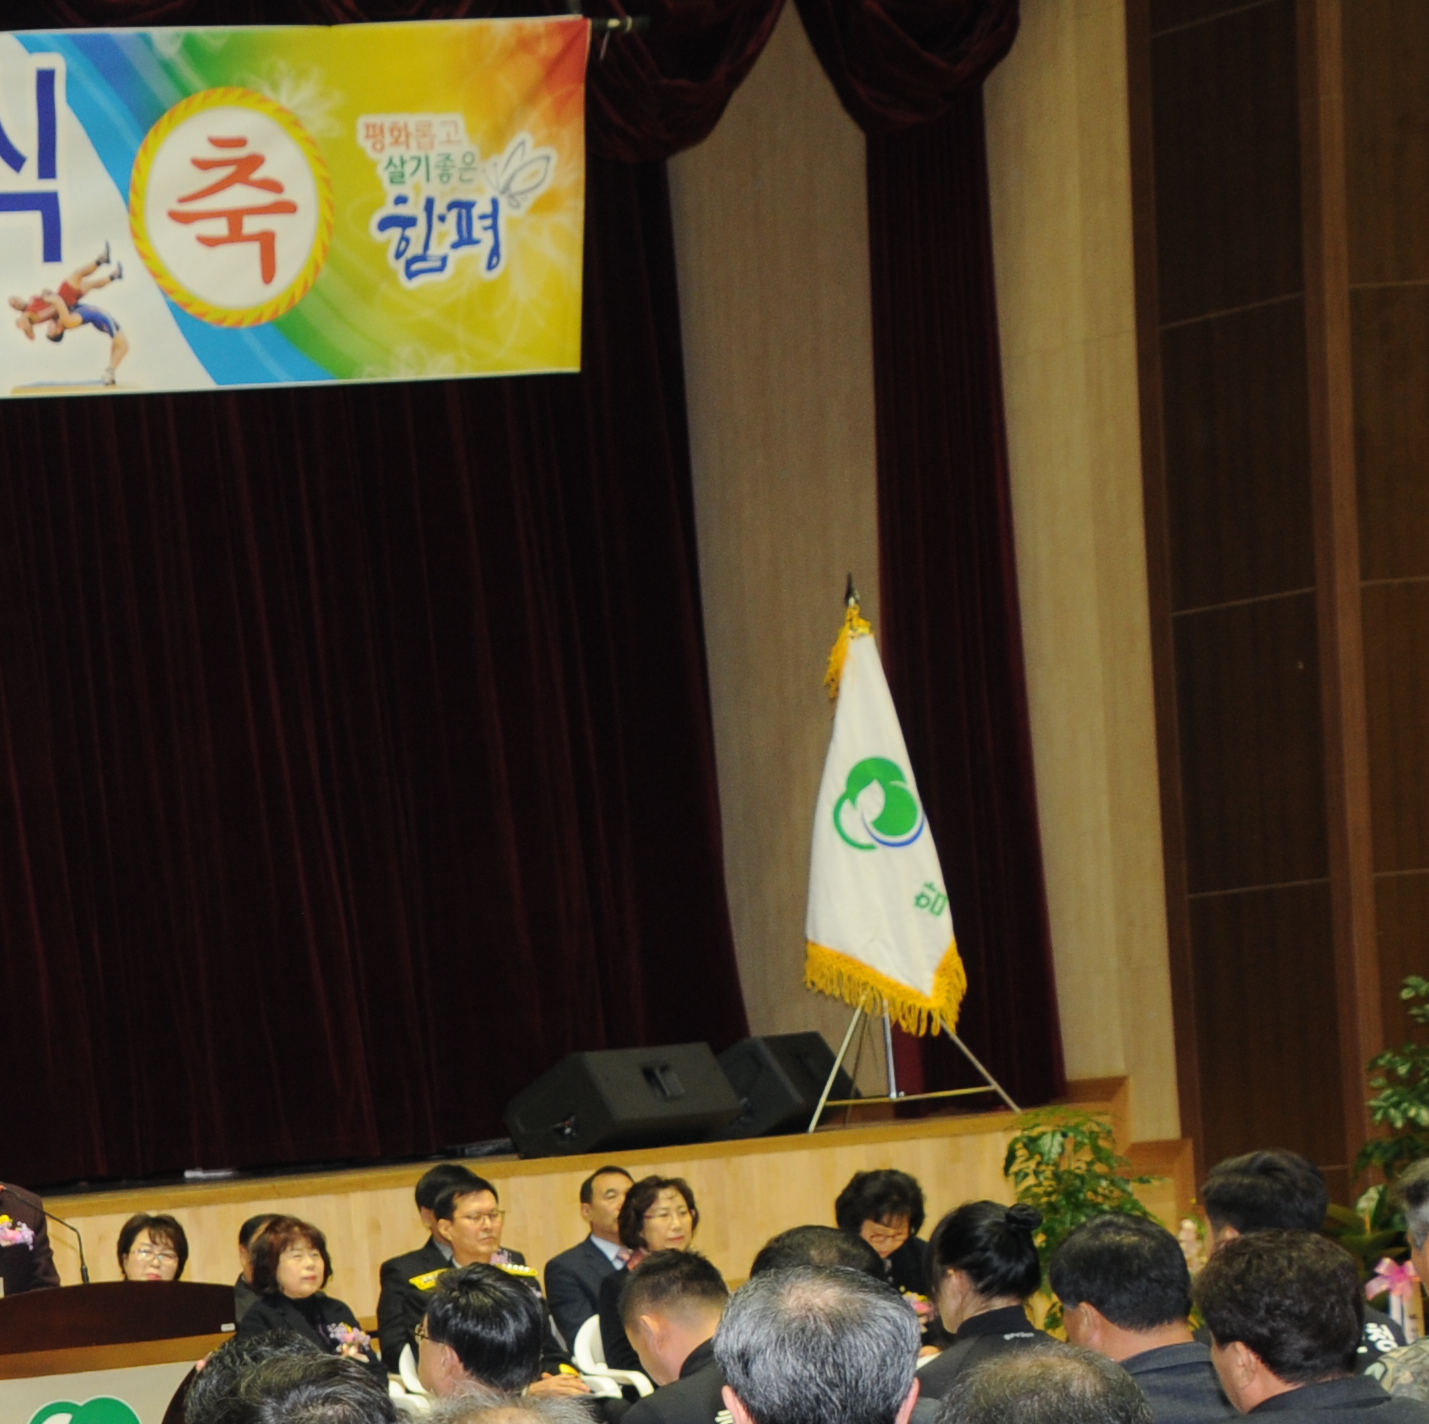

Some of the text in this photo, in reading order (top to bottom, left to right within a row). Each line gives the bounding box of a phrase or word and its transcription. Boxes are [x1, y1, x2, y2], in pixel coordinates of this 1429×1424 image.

[364, 119, 462, 152] 평화롭고
[167, 135, 298, 285] 축
[377, 194, 501, 280] 함평
